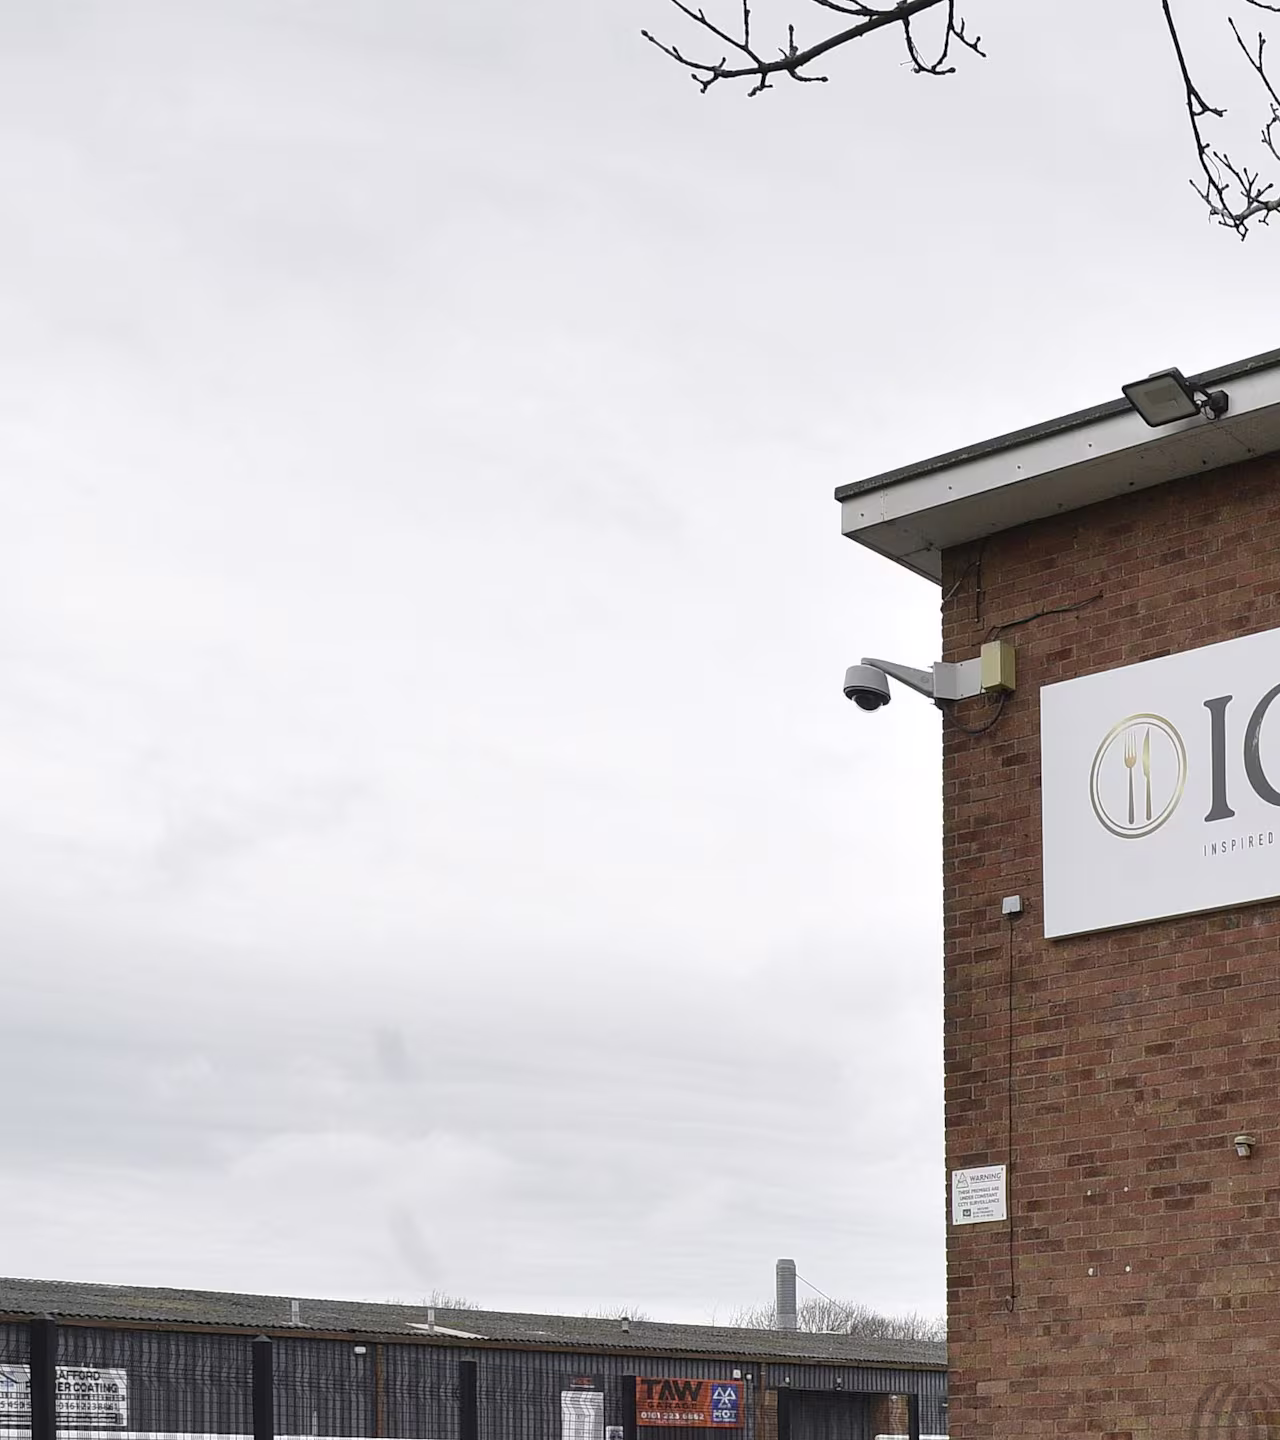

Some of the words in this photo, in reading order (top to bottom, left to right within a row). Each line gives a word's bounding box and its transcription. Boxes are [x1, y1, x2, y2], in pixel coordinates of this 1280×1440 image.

[1203, 831, 1274, 857] INSPIRED
[970, 1172, 1001, 1182] WARNING
[641, 1379, 703, 1401] TAW
[647, 1401, 697, 1410] GARAGE
